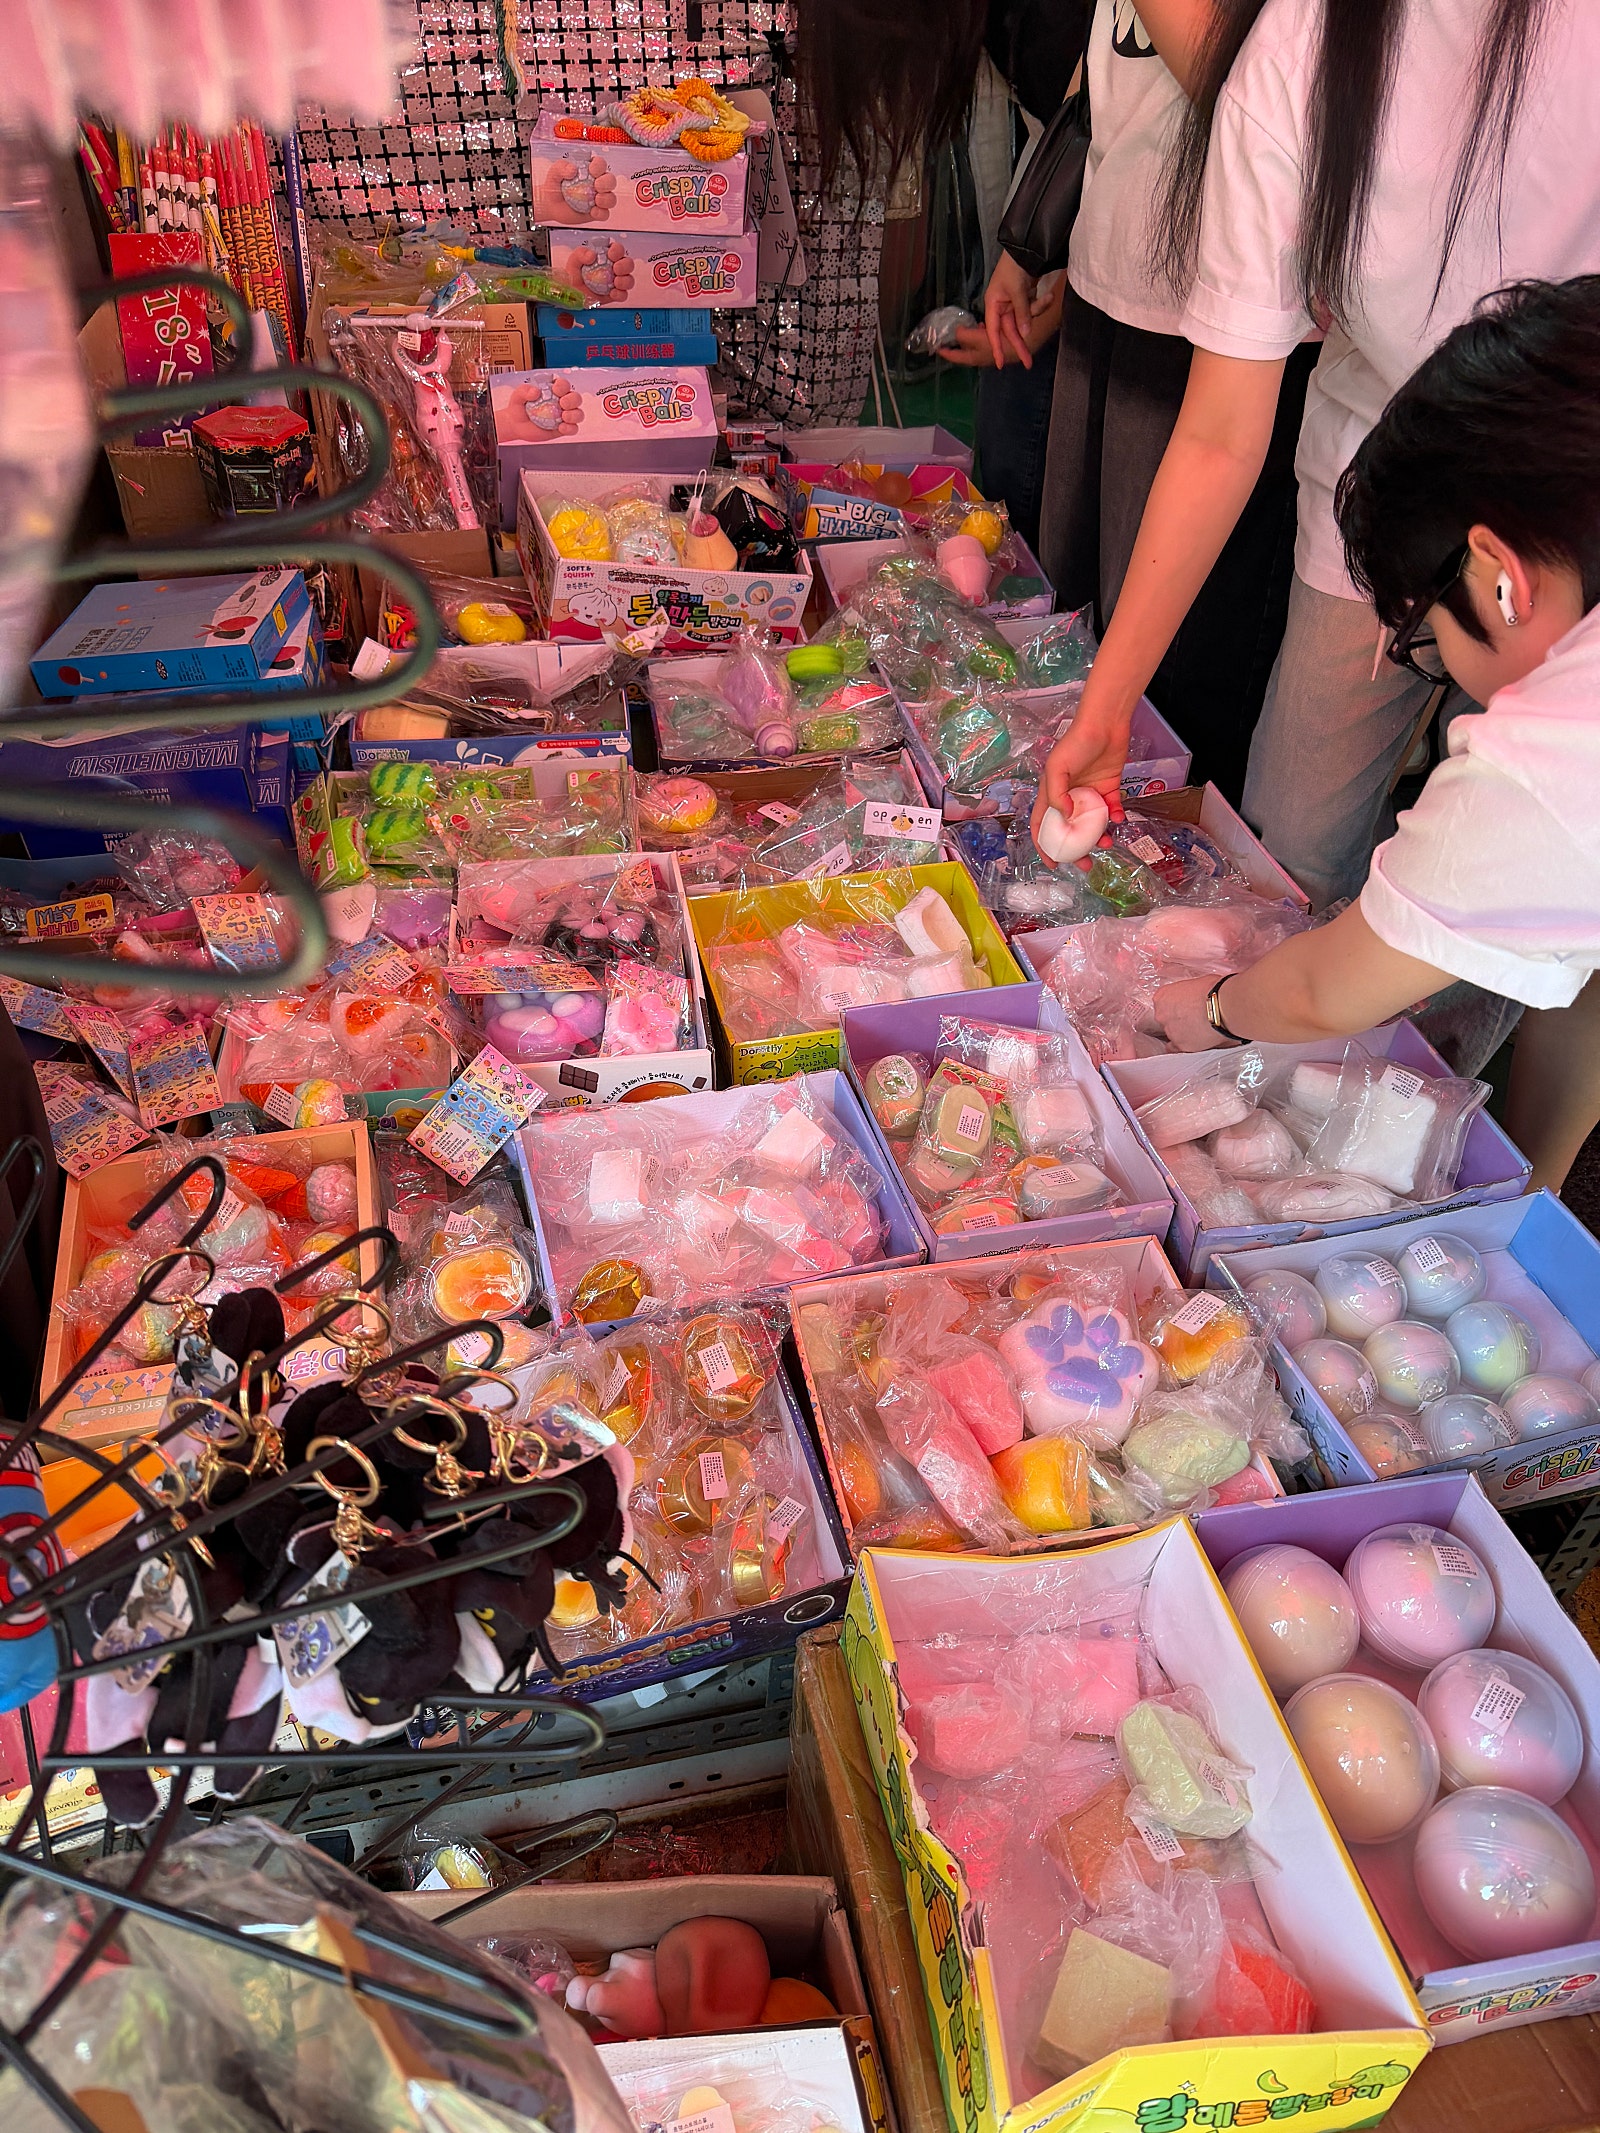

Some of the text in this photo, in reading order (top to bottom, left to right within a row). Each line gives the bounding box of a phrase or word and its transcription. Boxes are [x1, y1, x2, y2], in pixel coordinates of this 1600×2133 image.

[636, 175, 706, 202] Crispy
[669, 193, 721, 217] Balls
[241, 203, 262, 274] CANDLE
[253, 207, 274, 278] CANDLE
[653, 256, 720, 282] Crispy
[686, 271, 736, 294] Balls
[586, 343, 676, 361] 乒乓球训练器
[603, 387, 673, 415] Crispy
[638, 401, 693, 424] Balls
[67, 745, 240, 778] MAGNETISM
[872, 809, 888, 824] op
[917, 816, 933, 826] en
[99, 1399, 163, 1417] STICKERS
[1505, 1442, 1598, 1487] Crispy
[1428, 1981, 1563, 2024] Crispy
[1483, 1990, 1577, 2022] Balls
